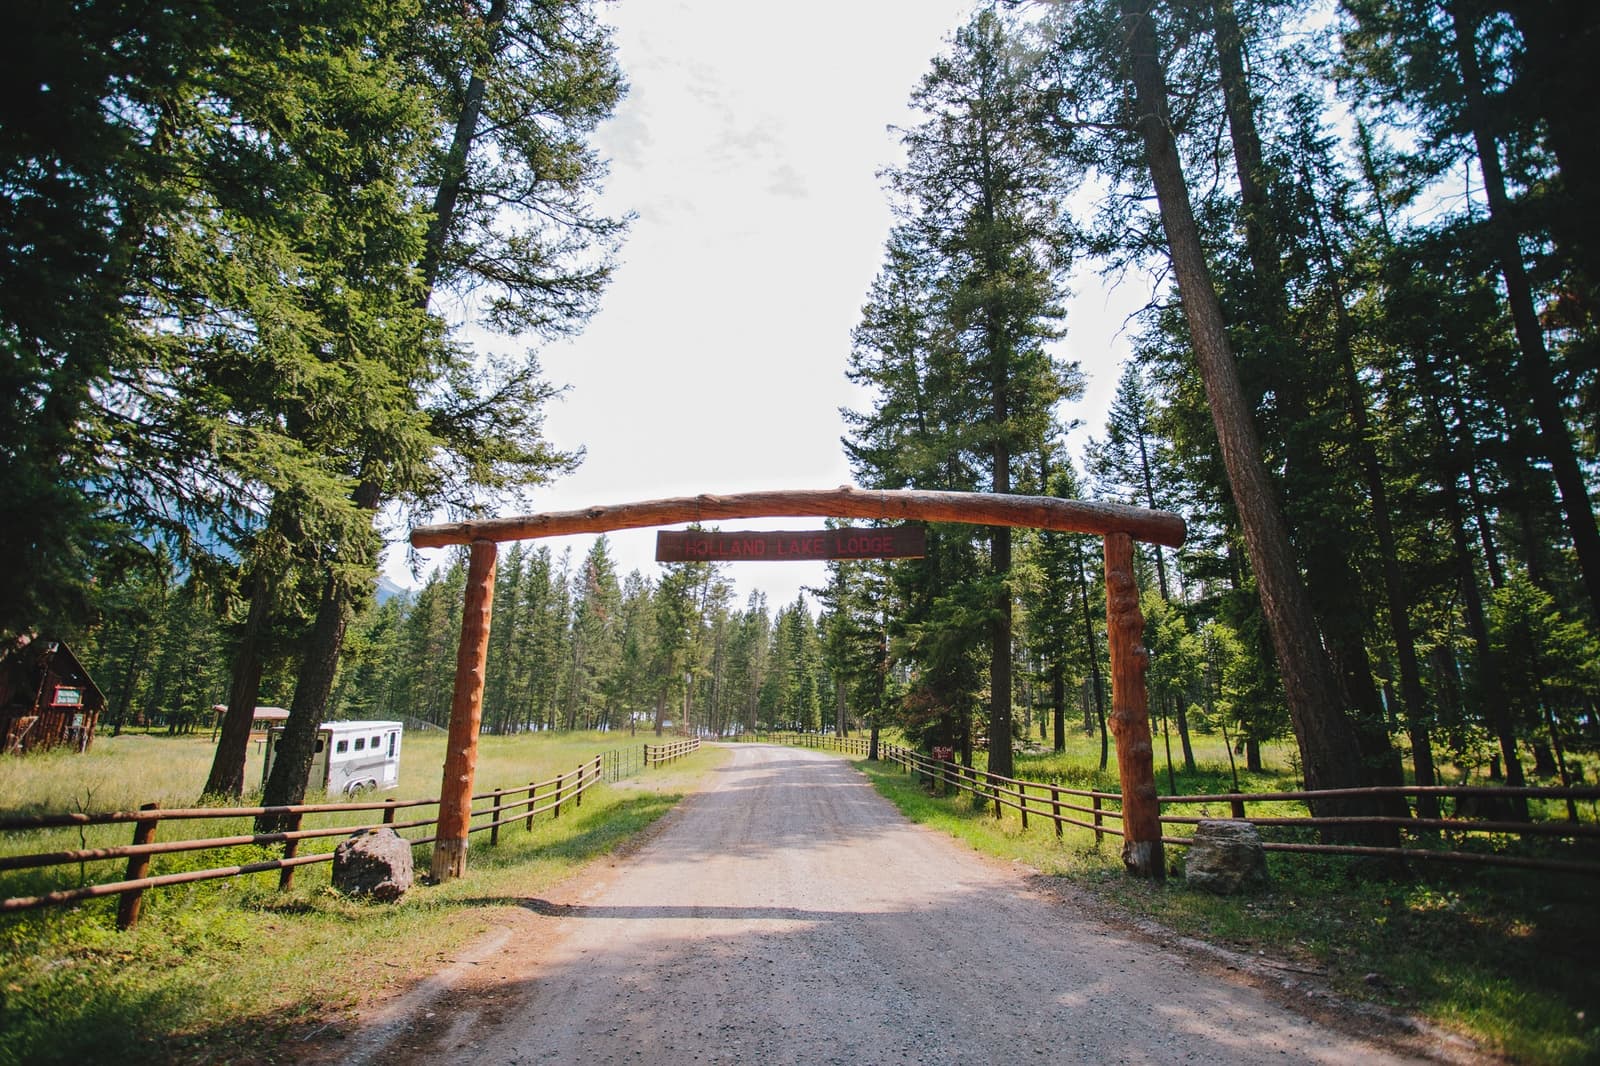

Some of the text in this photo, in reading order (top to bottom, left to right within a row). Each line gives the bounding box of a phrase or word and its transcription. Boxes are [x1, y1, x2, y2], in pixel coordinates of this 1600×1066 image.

[685, 536, 896, 557] HOLLAND LAKE LODGE
